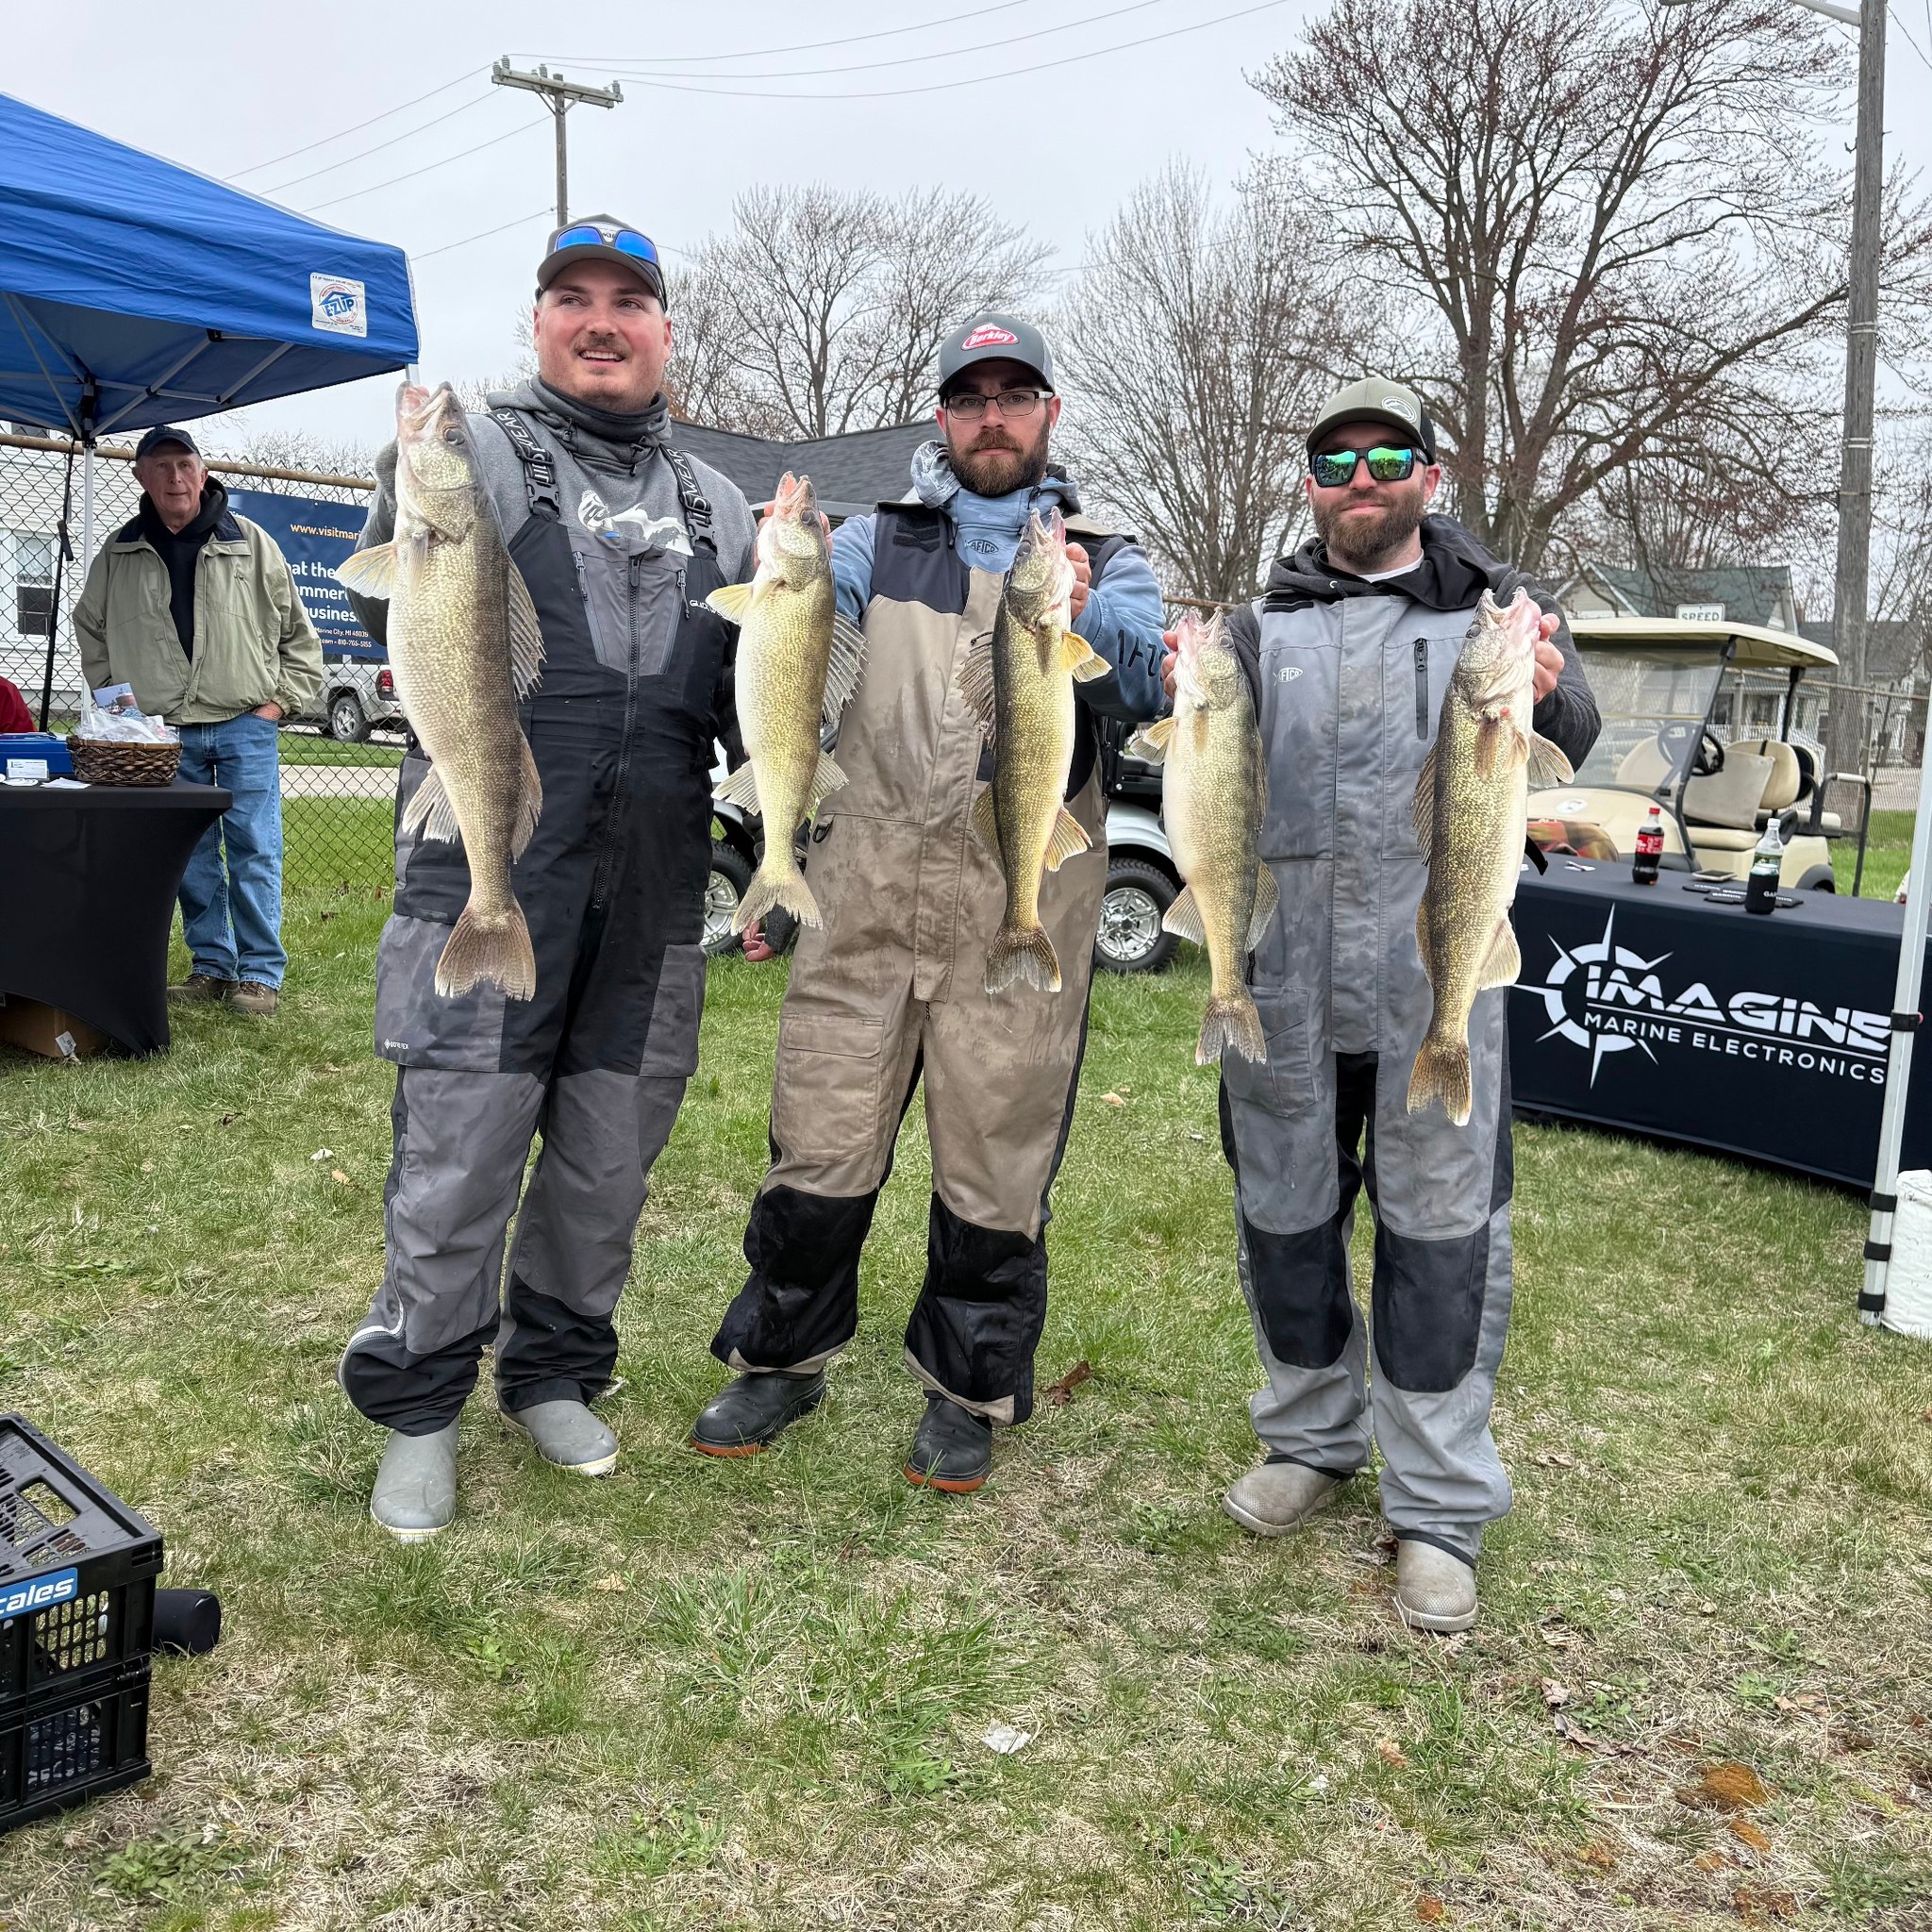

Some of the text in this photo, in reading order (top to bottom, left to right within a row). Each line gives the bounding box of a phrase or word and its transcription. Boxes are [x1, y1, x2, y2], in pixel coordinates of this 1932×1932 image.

[969, 330, 1011, 345] Berkley
[970, 540, 996, 554] AFTCO
[1681, 611, 1720, 622] SPEED
[1584, 1011, 1886, 1085] MARINE ELECTRONICS
